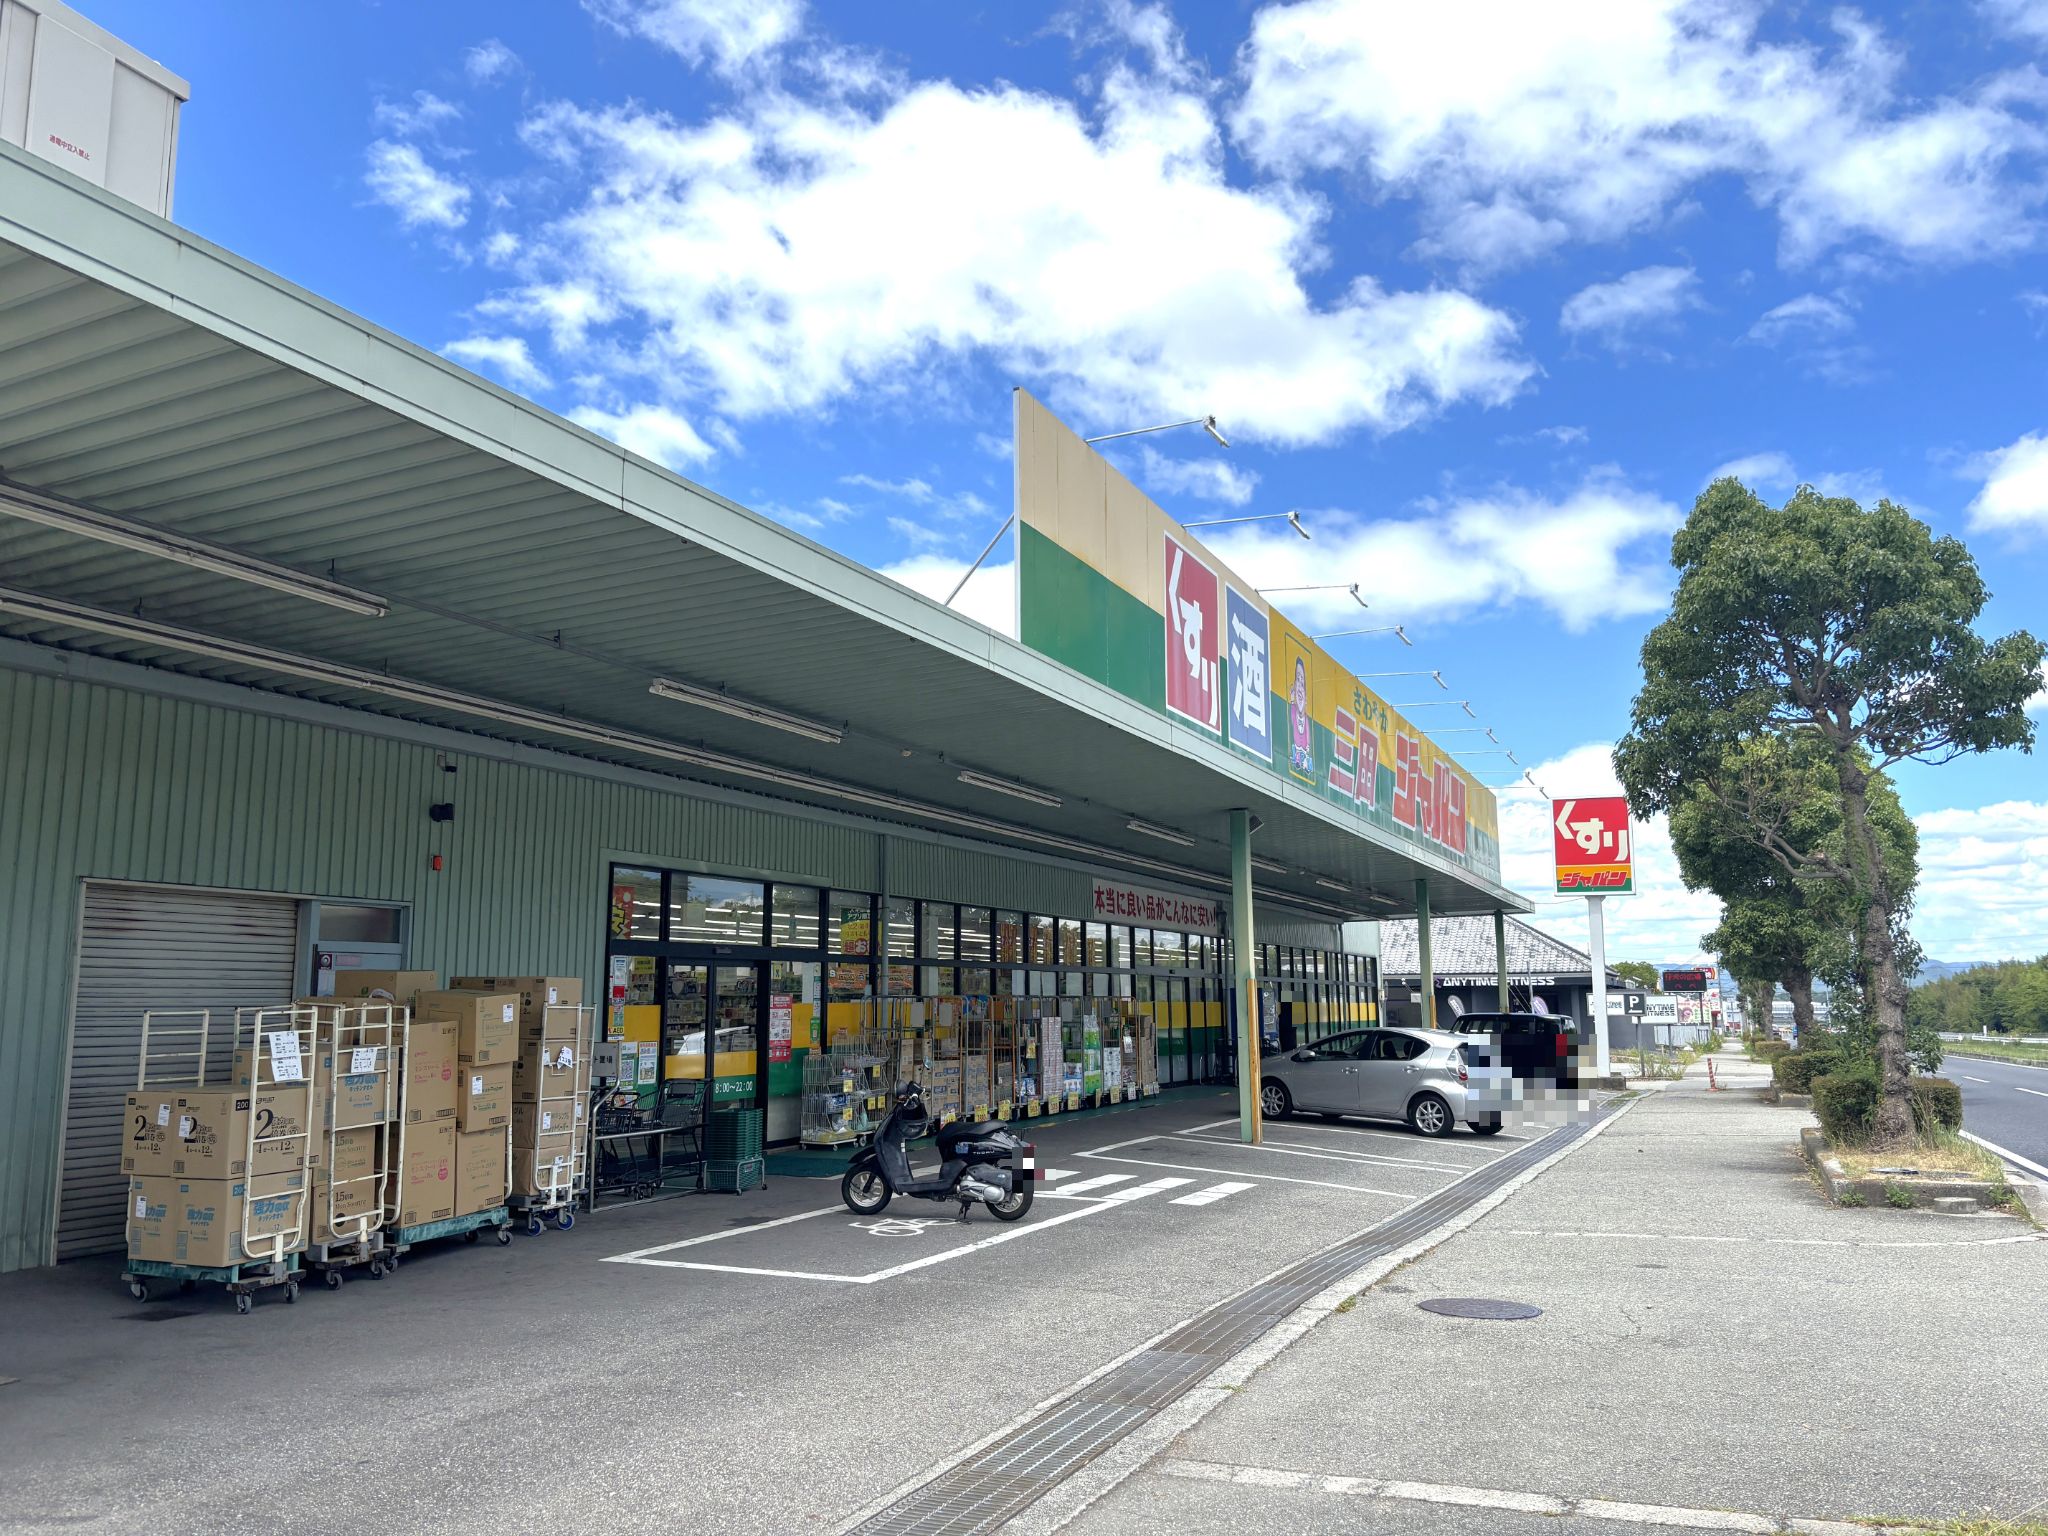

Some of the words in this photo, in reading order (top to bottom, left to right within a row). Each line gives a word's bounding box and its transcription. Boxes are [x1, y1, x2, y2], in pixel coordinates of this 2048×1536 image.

[1168, 548, 1218, 726] くすり
[1231, 612, 1267, 737] 酒
[1353, 687, 1389, 734] さわやか
[1392, 730, 1467, 857] ジャパン
[1555, 800, 1629, 862] くすり
[1559, 870, 1628, 888] ジャパン
[1443, 977, 1498, 987] ANYTIME
[1629, 996, 1639, 1008] P
[1646, 1003, 1675, 1011] NYTIME
